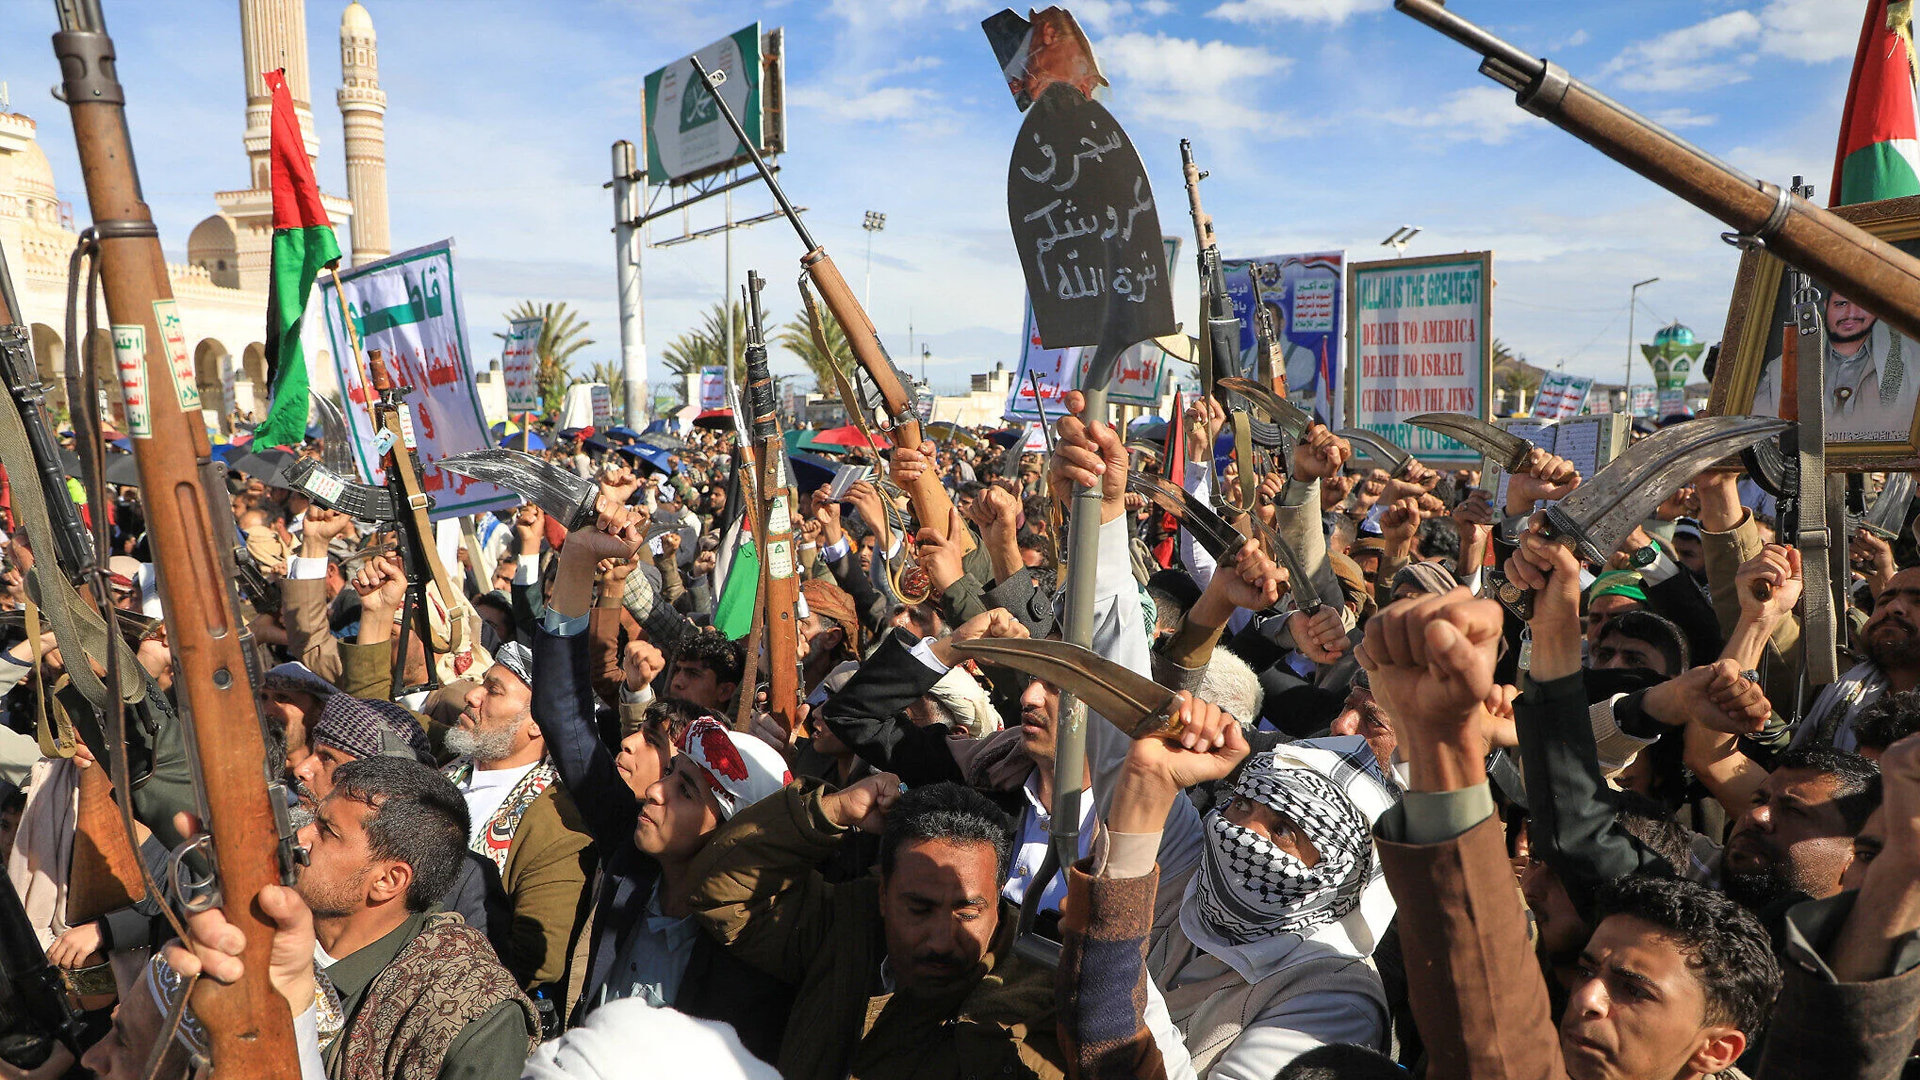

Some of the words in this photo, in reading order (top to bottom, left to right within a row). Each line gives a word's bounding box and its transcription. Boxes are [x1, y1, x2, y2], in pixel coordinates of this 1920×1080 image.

[1058, 249, 1106, 300] الله
[1362, 275, 1392, 310] ALLAH
[1394, 275, 1403, 308] IS
[1406, 274, 1424, 307] THE
[1427, 270, 1480, 306] GREATEST
[115, 332, 139, 349] الله
[1363, 322, 1399, 346] DEATH
[1403, 321, 1418, 345] TO
[1421, 319, 1476, 344] AMERICA
[1363, 354, 1399, 378] DEATH
[1403, 353, 1418, 377] TO
[1421, 352, 1464, 377] ISRAEL
[1362, 389, 1392, 412] CURSE
[1394, 388, 1421, 412] UPON
[1424, 388, 1444, 411] THE
[1446, 387, 1474, 411] JEWS
[1417, 426, 1433, 449] TO
